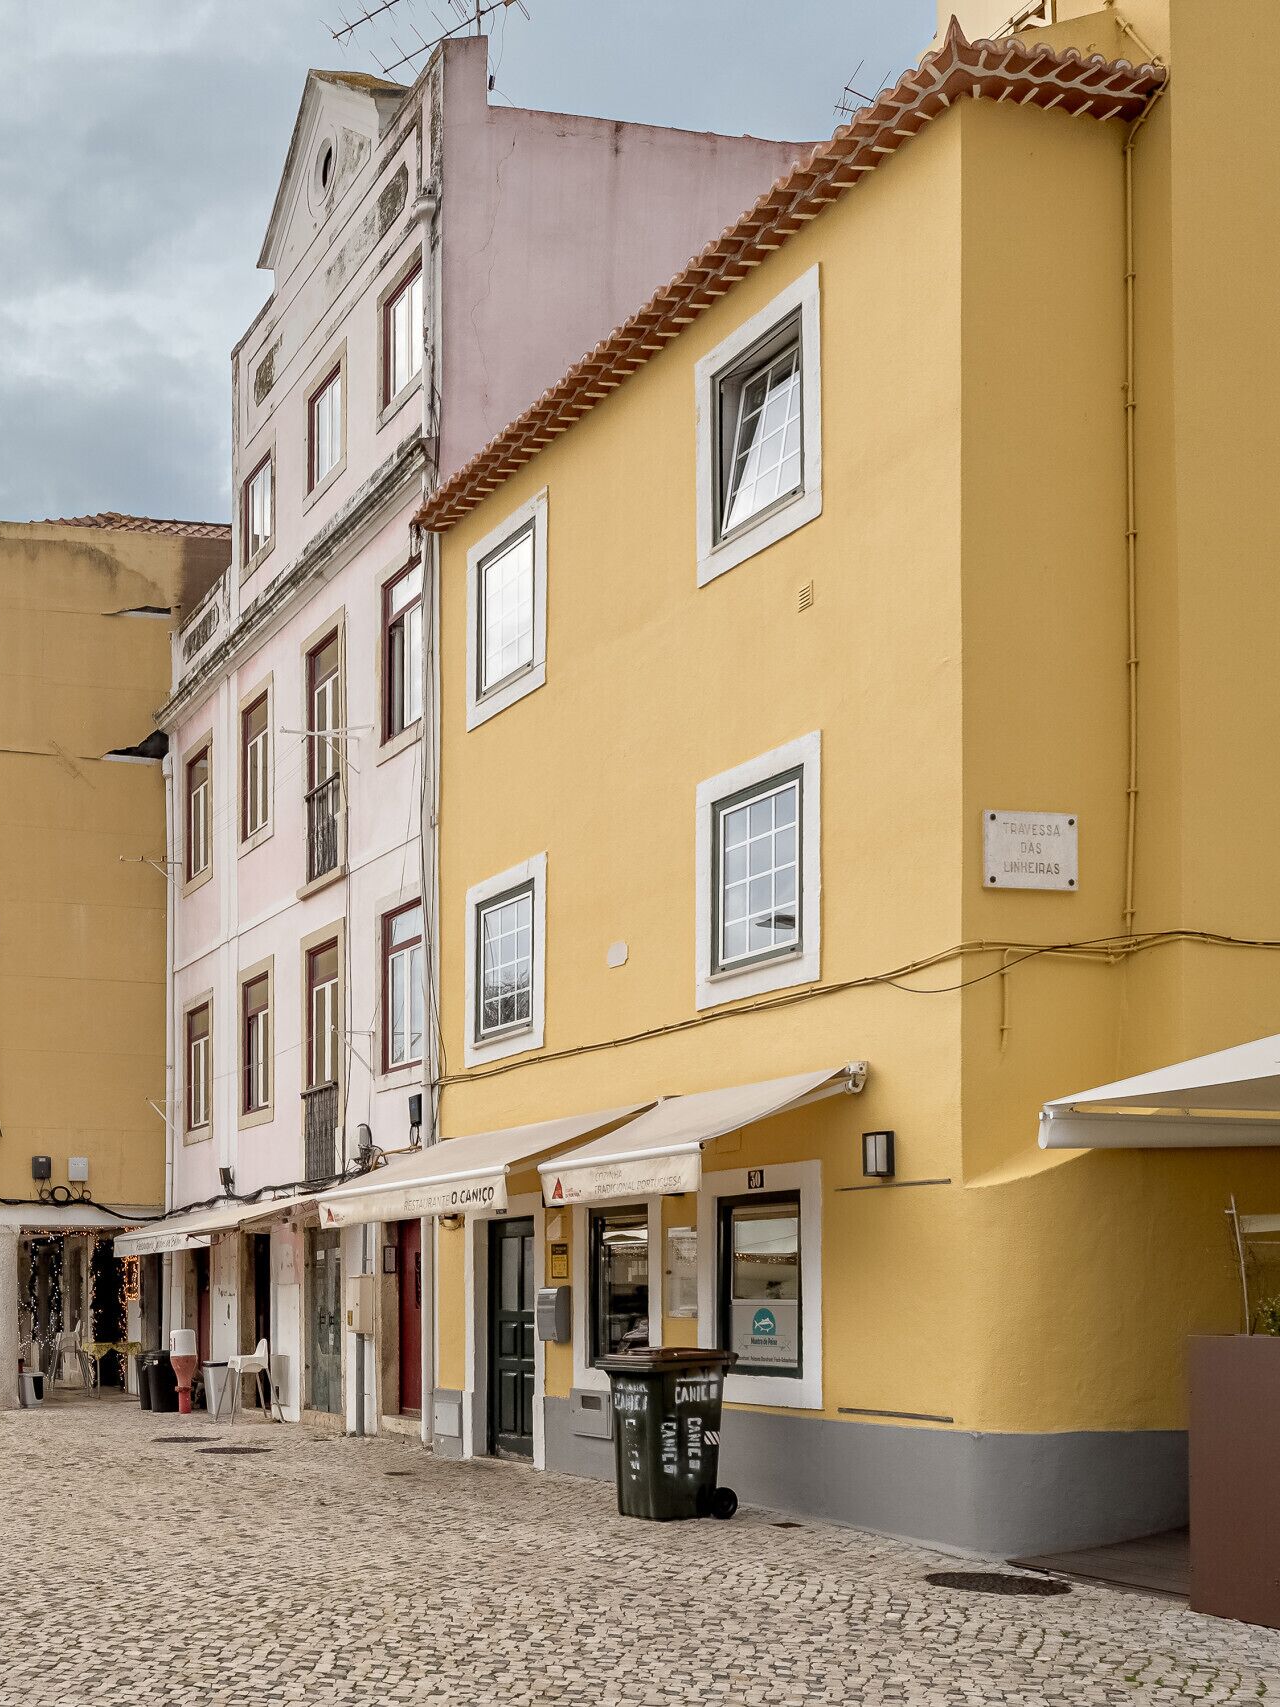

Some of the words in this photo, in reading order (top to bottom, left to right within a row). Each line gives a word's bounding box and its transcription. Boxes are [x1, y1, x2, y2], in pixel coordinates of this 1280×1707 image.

[1003, 822, 1060, 836] TRAVESSA
[1020, 842, 1042, 854] DAS
[1003, 861, 1060, 875] LINHEIRAS
[594, 1182, 635, 1194] TRADICIONAL
[636, 1175, 682, 1190] PORTUGUESA
[750, 1170, 761, 1187] 30
[403, 1195, 451, 1212] RESTAURANTE
[451, 1191, 458, 1205] O
[459, 1186, 494, 1205] CANIÇO
